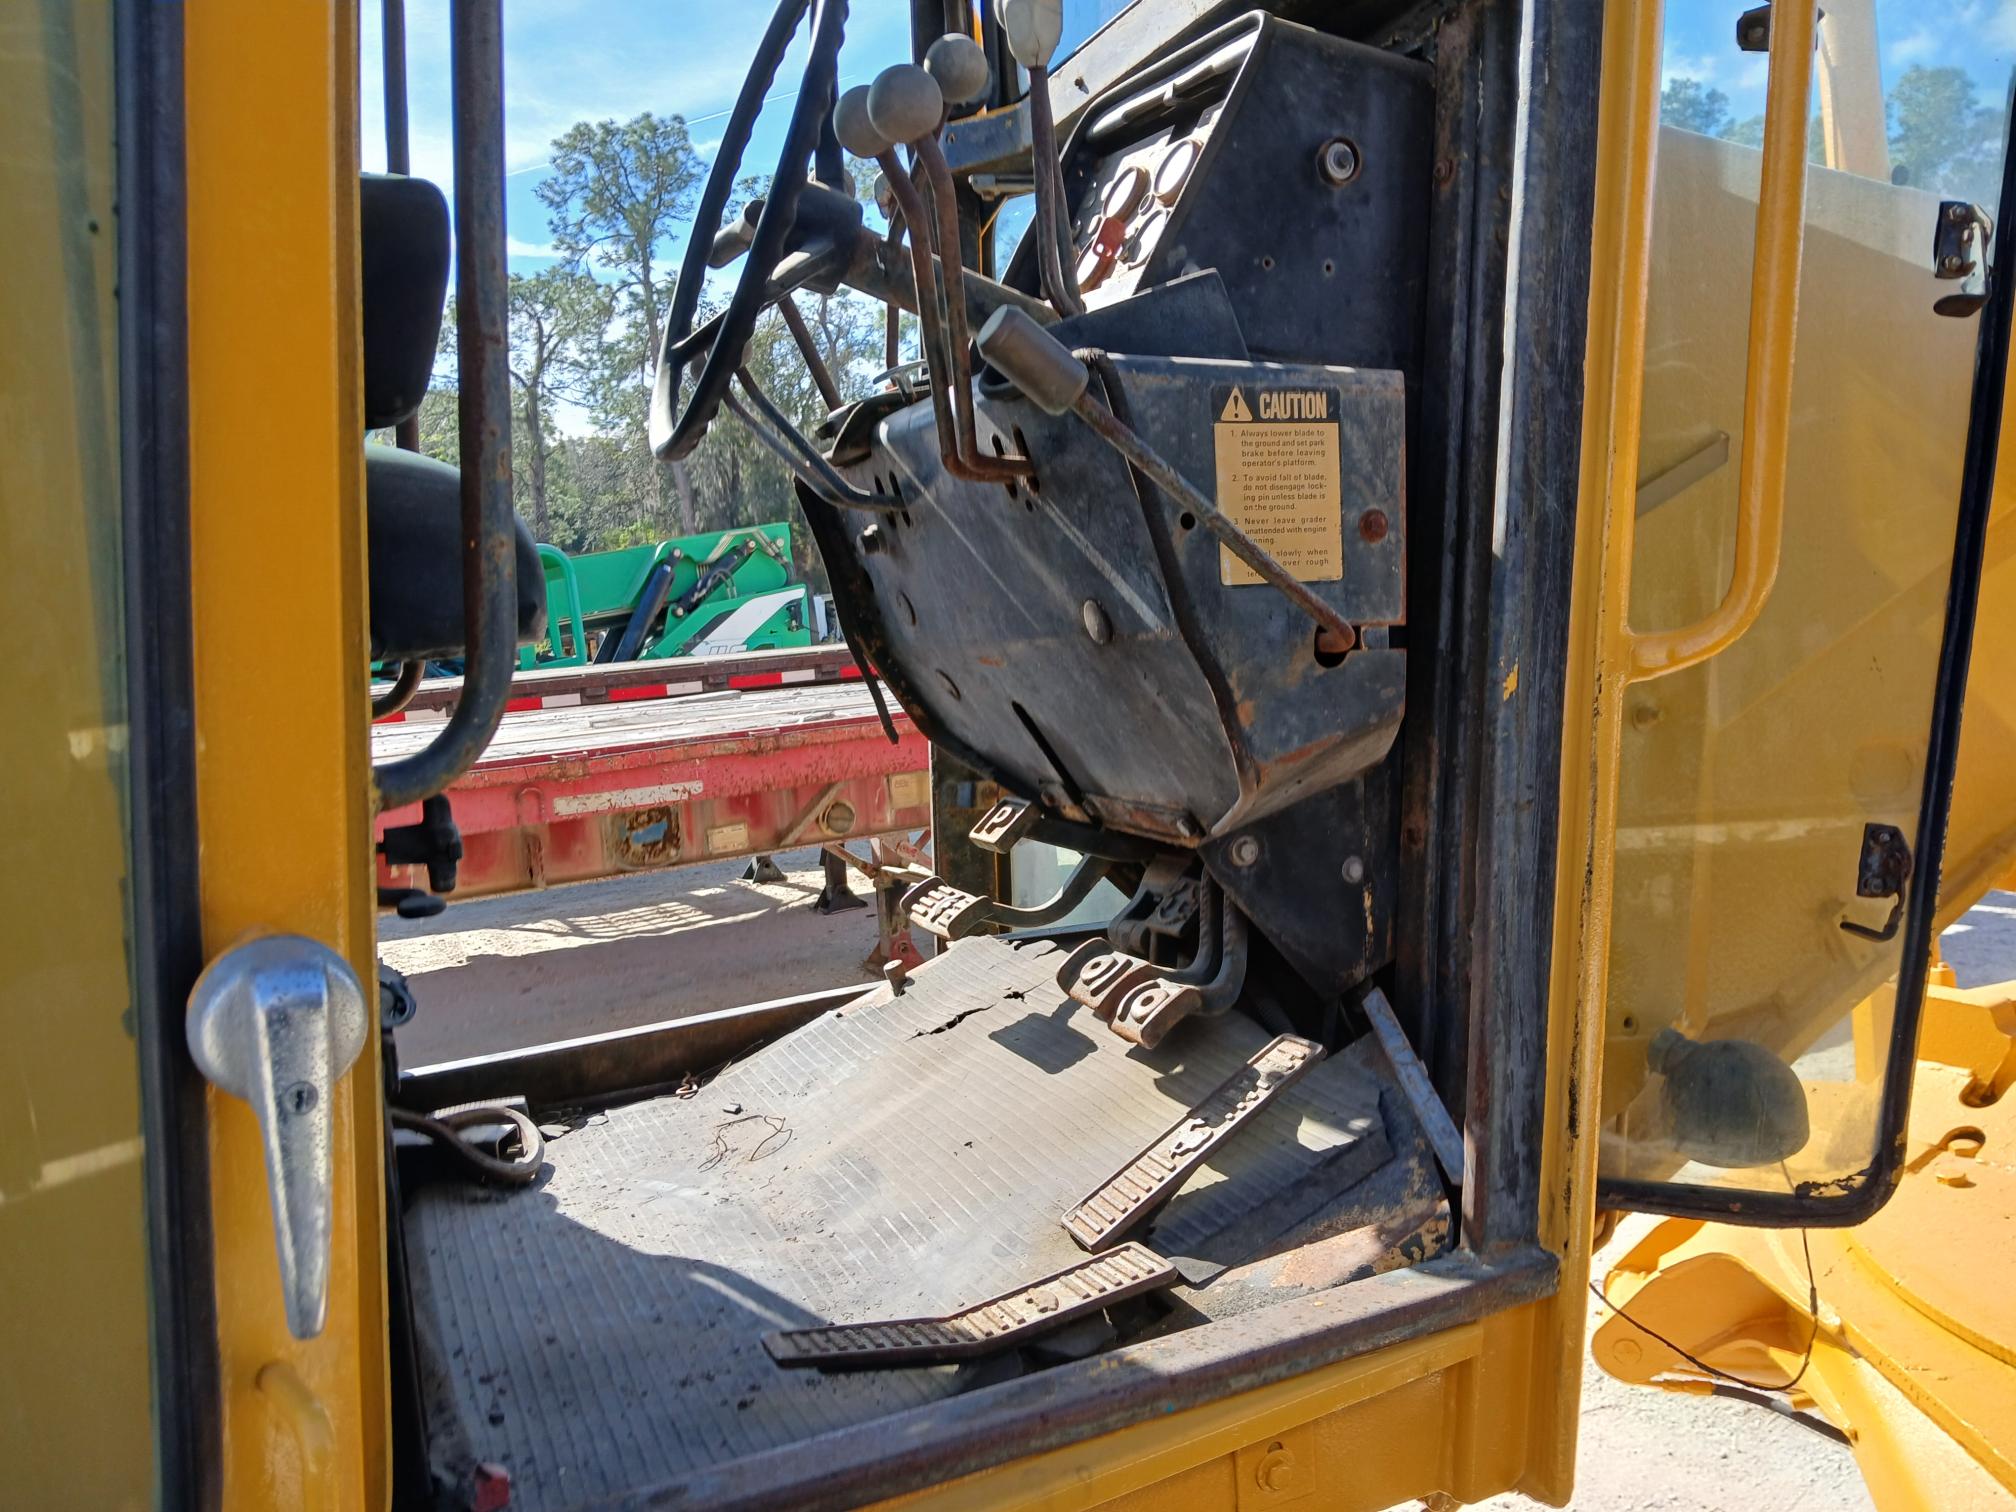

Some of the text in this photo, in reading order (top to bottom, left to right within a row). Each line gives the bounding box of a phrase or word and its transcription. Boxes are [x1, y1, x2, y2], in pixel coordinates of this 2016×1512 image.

[1260, 391, 1328, 420] CAUTION
[1241, 429, 1268, 438] Always
[1270, 429, 1292, 437] lower
[1294, 429, 1314, 437] blade
[1255, 440, 1280, 448] ground
[1309, 439, 1325, 447] park
[1267, 449, 1293, 457] before
[1296, 449, 1326, 457] leaving
[1242, 459, 1316, 468] operator's platform.
[1304, 473, 1327, 481] blade,
[1269, 483, 1305, 491] disengage
[1243, 494, 1255, 502] ing
[1258, 494, 1269, 502] pin
[1300, 516, 1327, 524] grader
[1303, 526, 1327, 534] engine
[1306, 548, 1328, 556] when
[1306, 558, 1329, 566] rough
